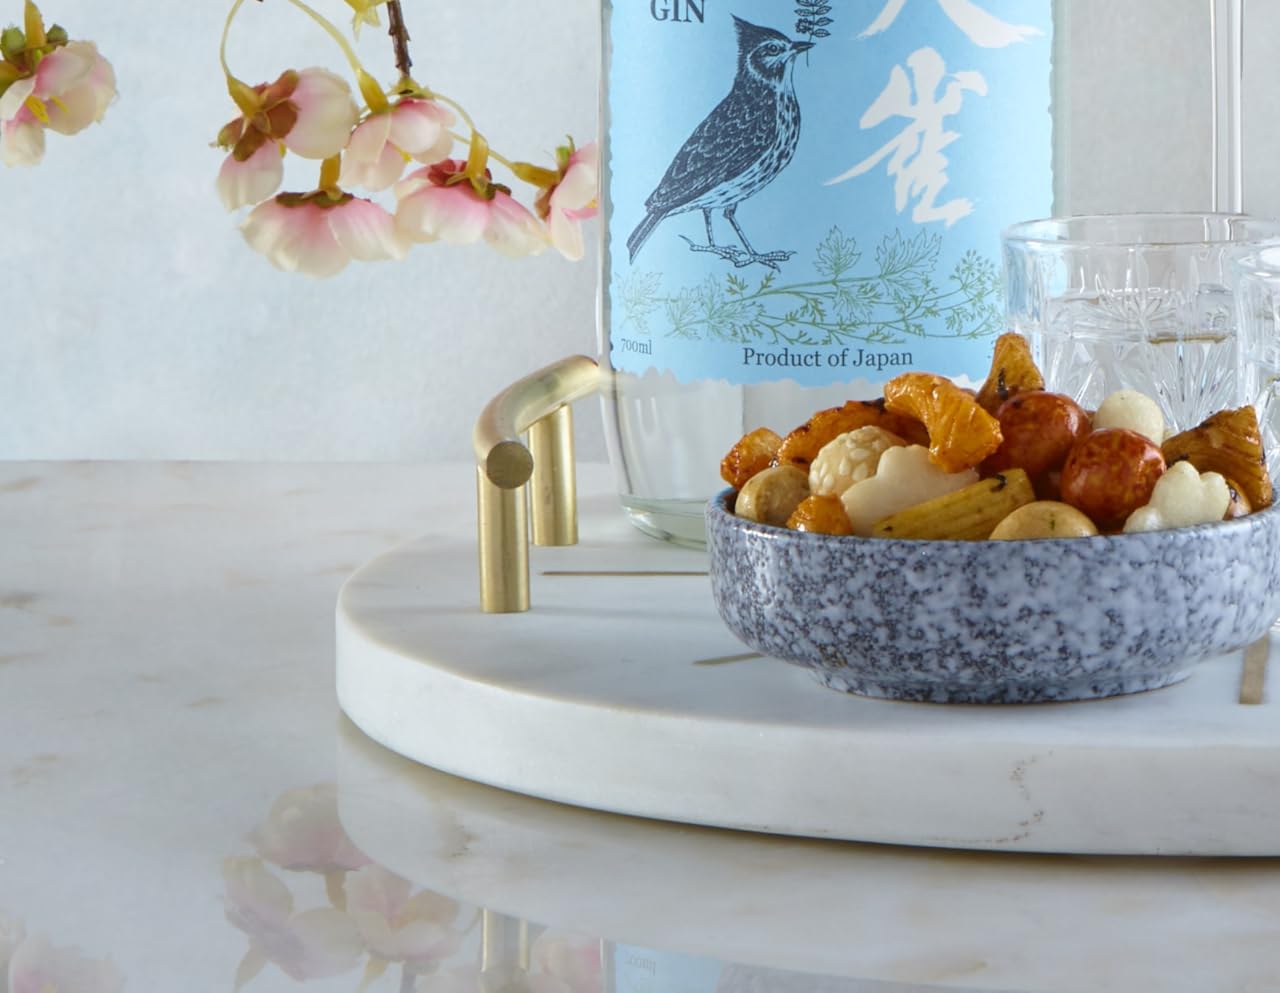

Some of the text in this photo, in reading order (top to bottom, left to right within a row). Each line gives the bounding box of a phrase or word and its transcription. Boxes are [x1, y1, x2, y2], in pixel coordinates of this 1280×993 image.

[620, 338, 652, 355] 700ml
[743, 347, 913, 371] Product of Japan
